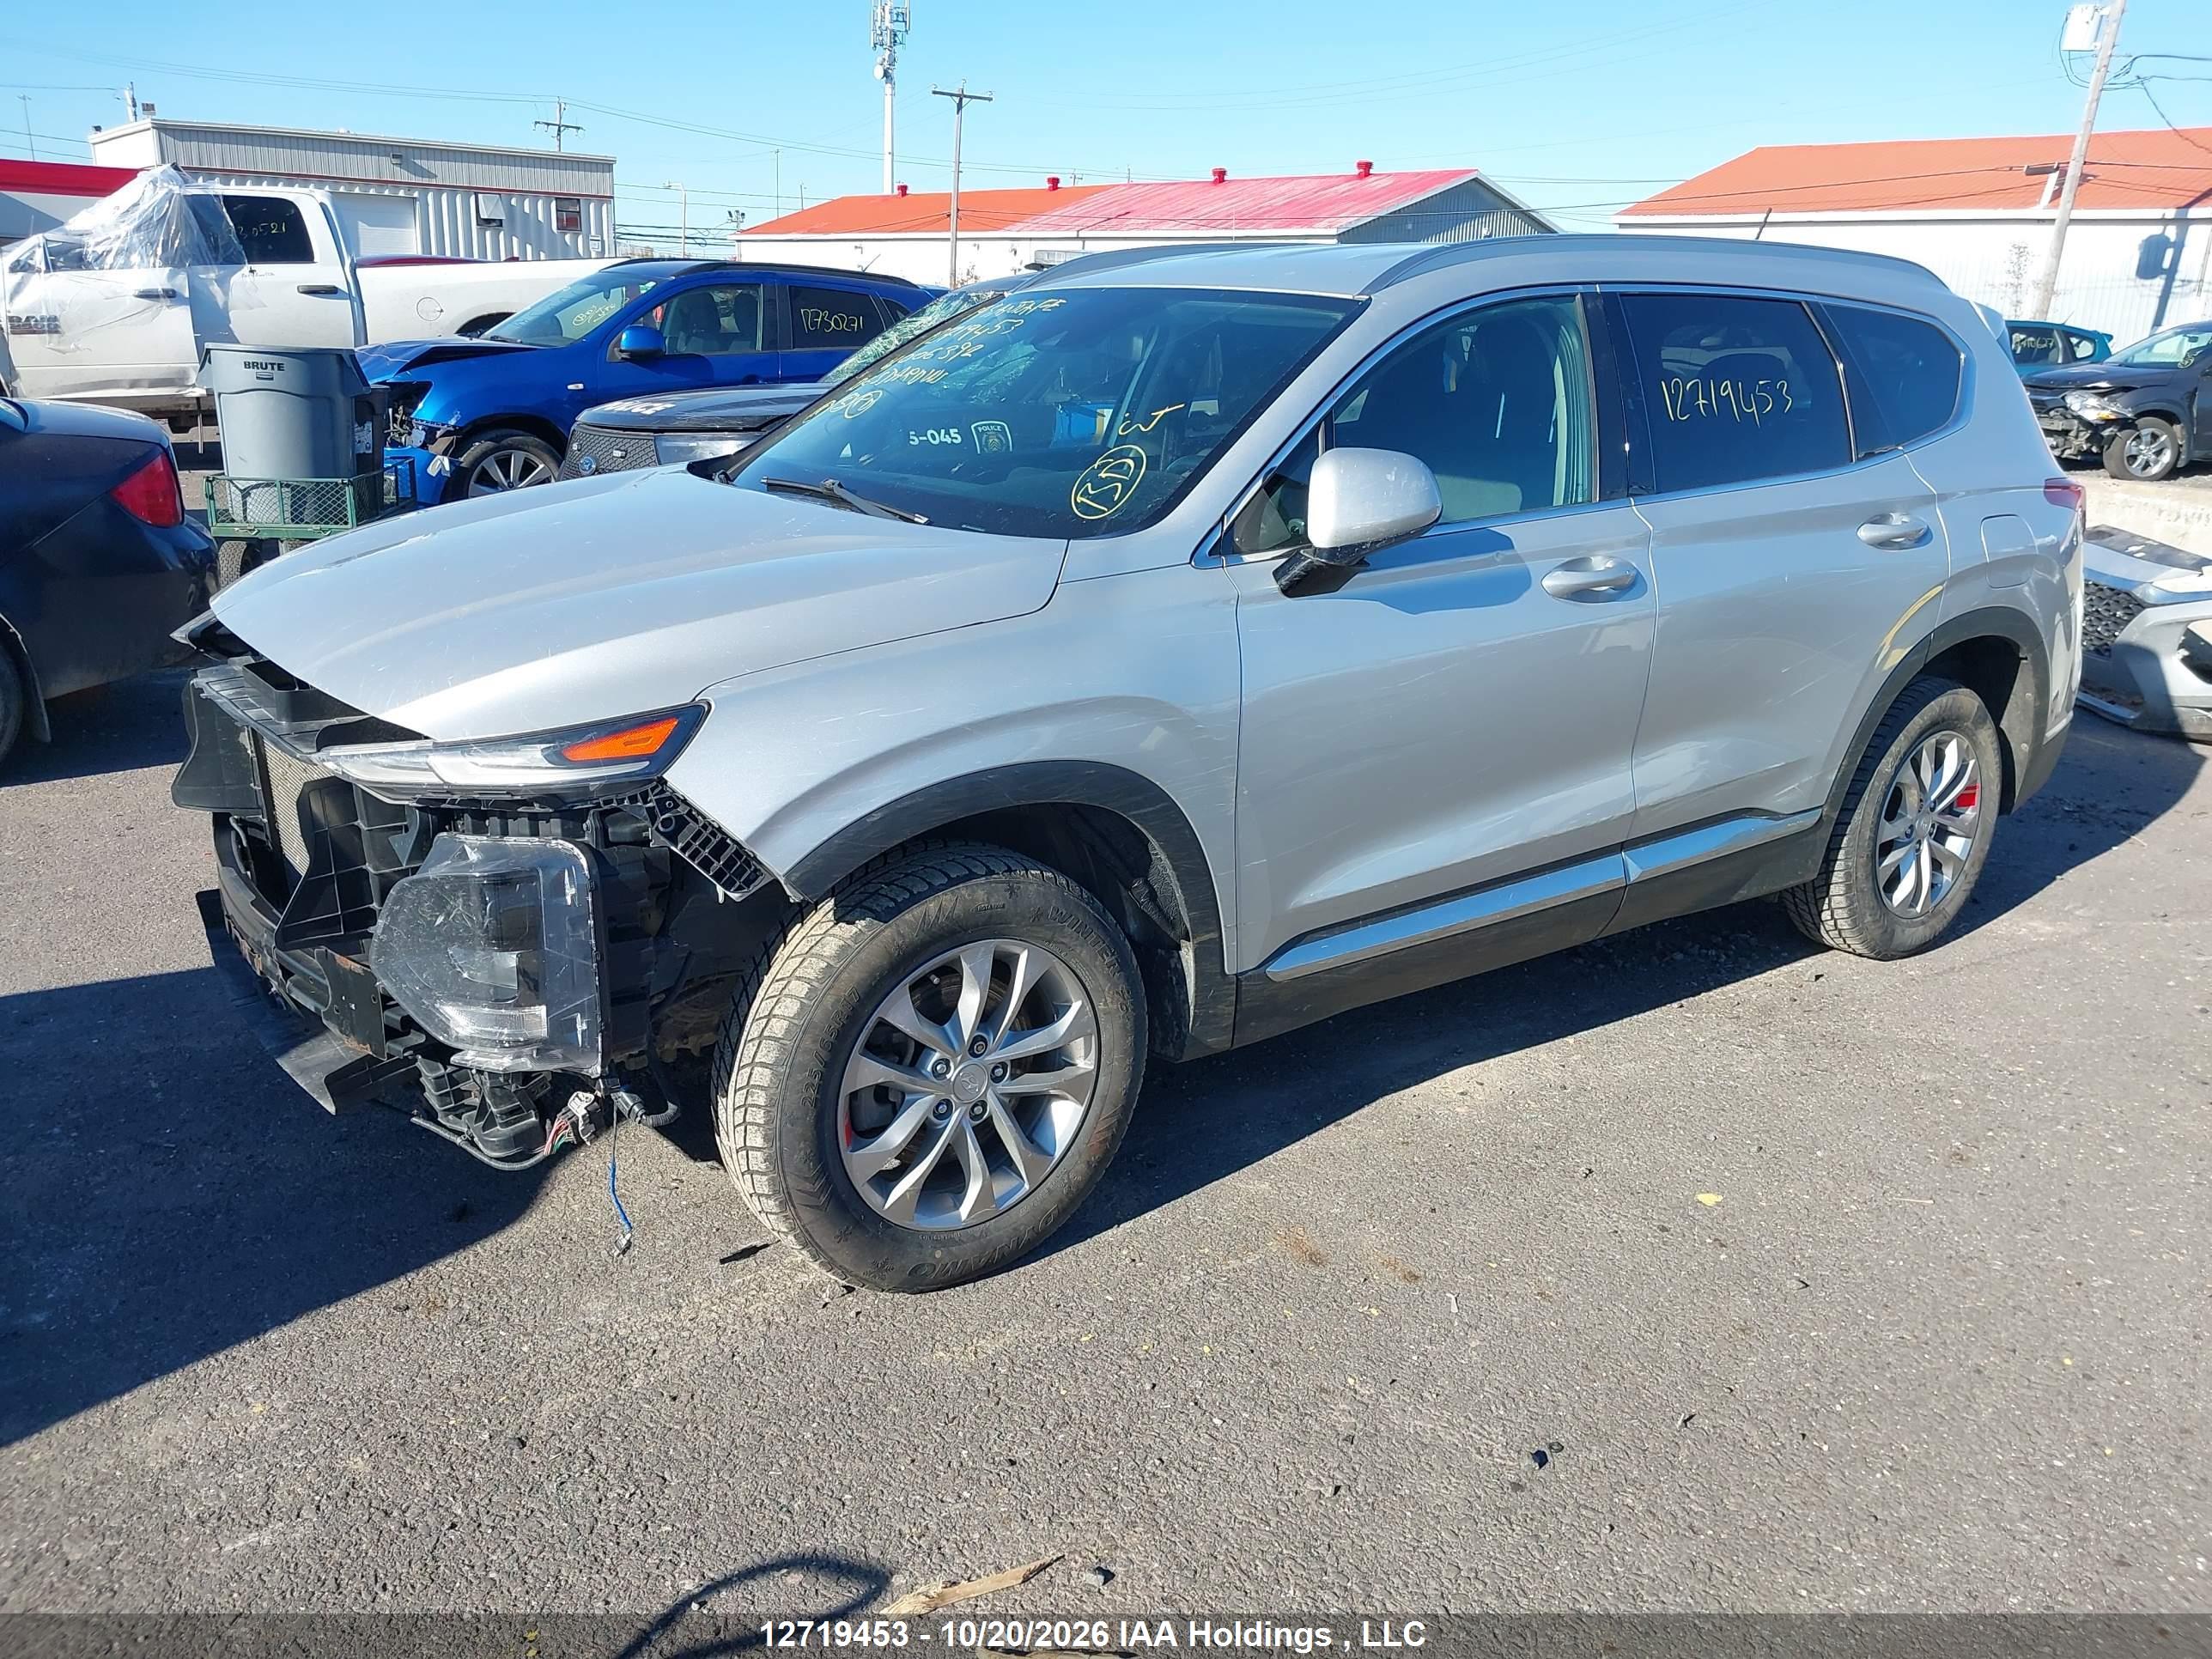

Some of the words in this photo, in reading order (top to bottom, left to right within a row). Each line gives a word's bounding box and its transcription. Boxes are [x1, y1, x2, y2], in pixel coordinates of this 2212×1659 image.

[244, 361, 285, 372] BRUTE
[1662, 378, 1793, 428] 12719453
[801, 985, 860, 1108] 225/65R17
